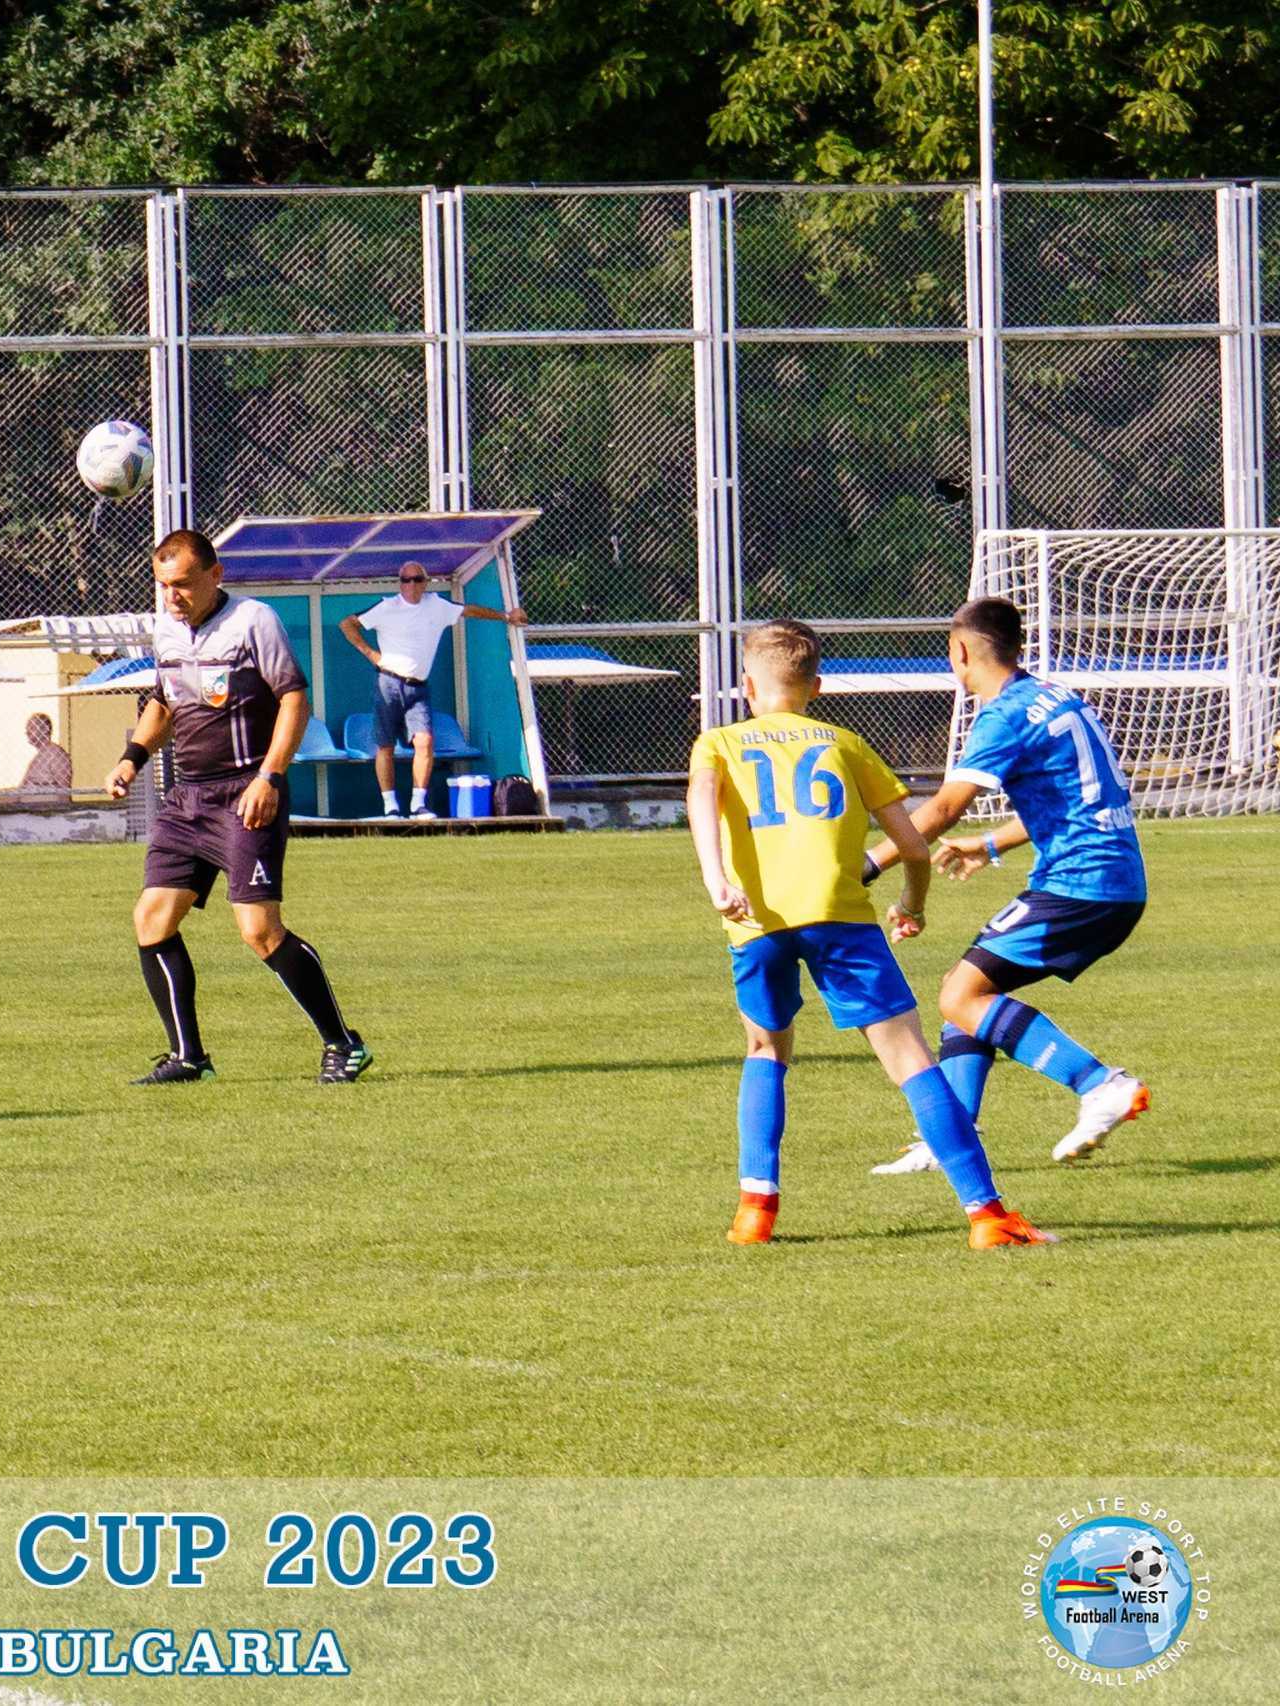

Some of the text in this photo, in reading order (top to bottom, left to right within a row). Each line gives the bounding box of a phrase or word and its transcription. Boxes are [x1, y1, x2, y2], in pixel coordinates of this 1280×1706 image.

[740, 727, 837, 745] AEROSTAR
[740, 744, 846, 831] 16
[248, 860, 272, 886] A
